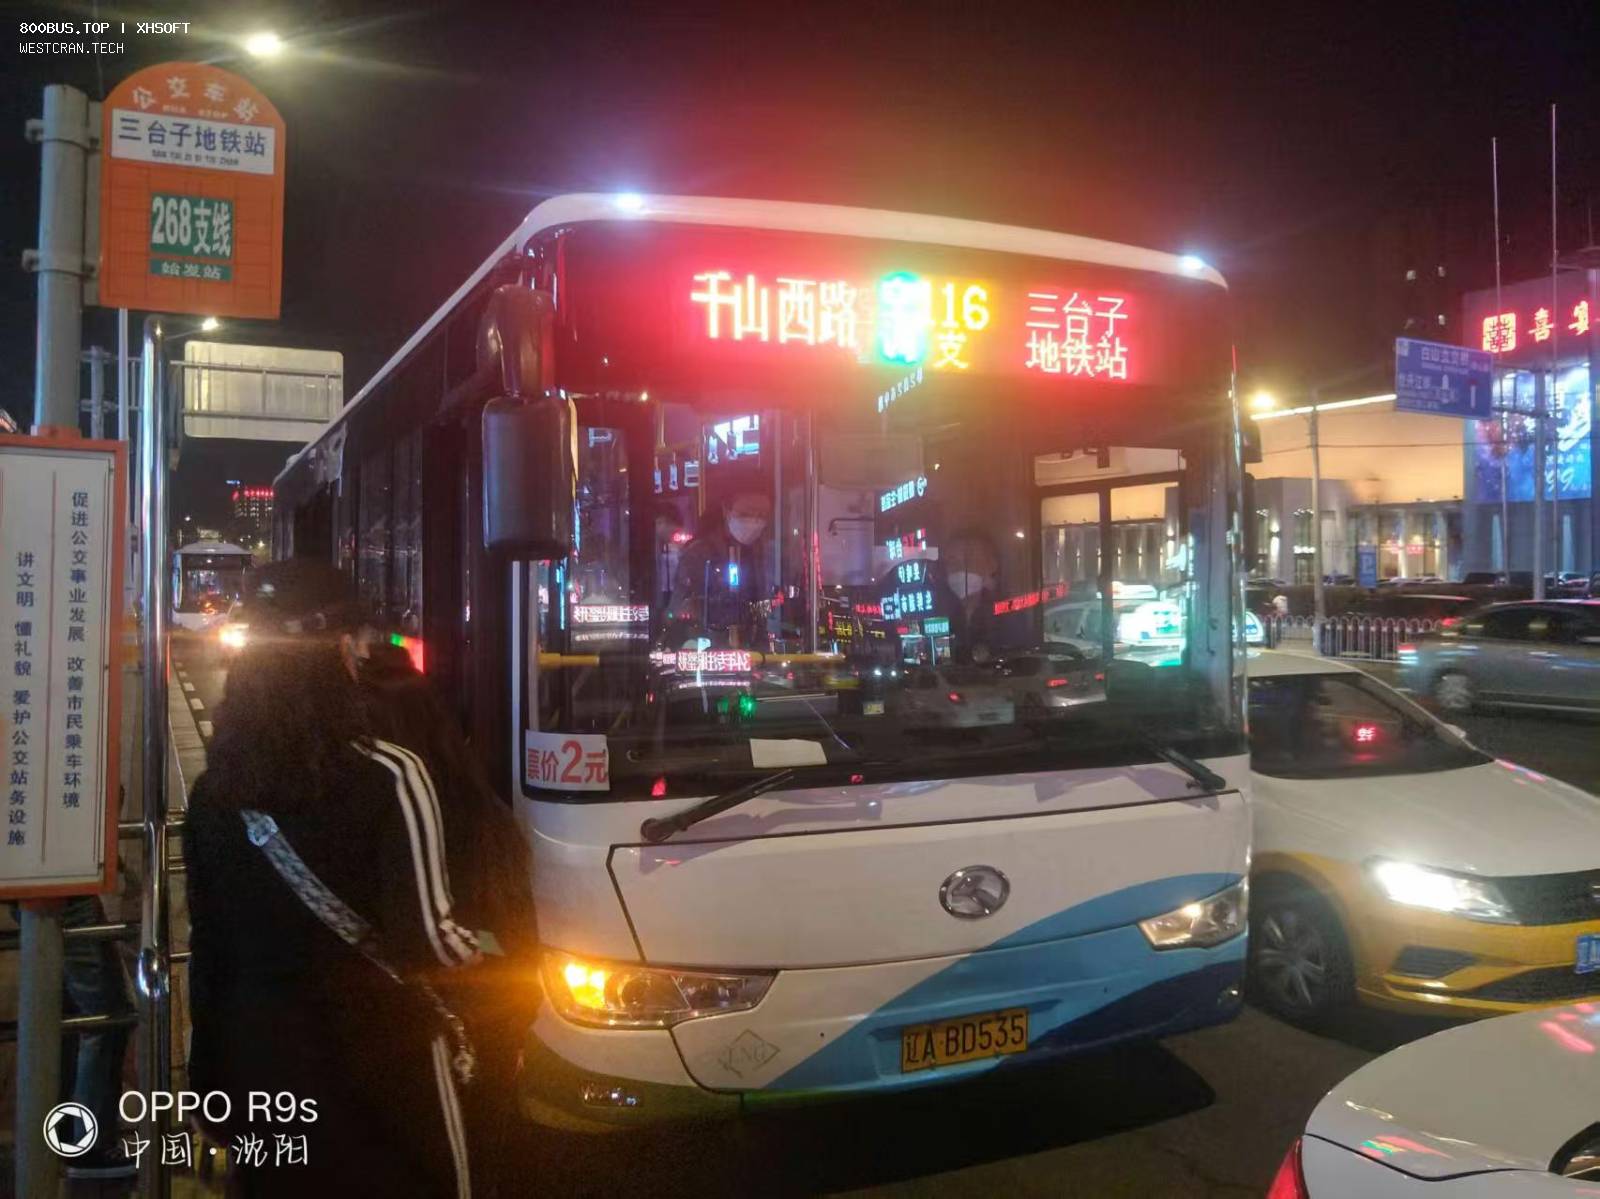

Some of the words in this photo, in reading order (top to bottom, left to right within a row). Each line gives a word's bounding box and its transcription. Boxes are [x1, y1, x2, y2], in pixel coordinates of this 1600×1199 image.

[118, 117, 267, 157] 三台子地铁站
[151, 196, 232, 257] 268支线
[161, 260, 223, 280] 始发站
[690, 271, 858, 349] 千山西路
[1025, 291, 1129, 338] 三台子
[1025, 332, 1128, 380] 地铁站
[15, 551, 35, 608] 讲文明
[67, 491, 90, 644] 促进公交事业发展
[14, 620, 33, 677] 懂礼貌
[62, 656, 85, 809] 改善市民乘车环境
[7, 689, 31, 847] 爱护公交站务设施
[526, 739, 608, 784] 票价2元
